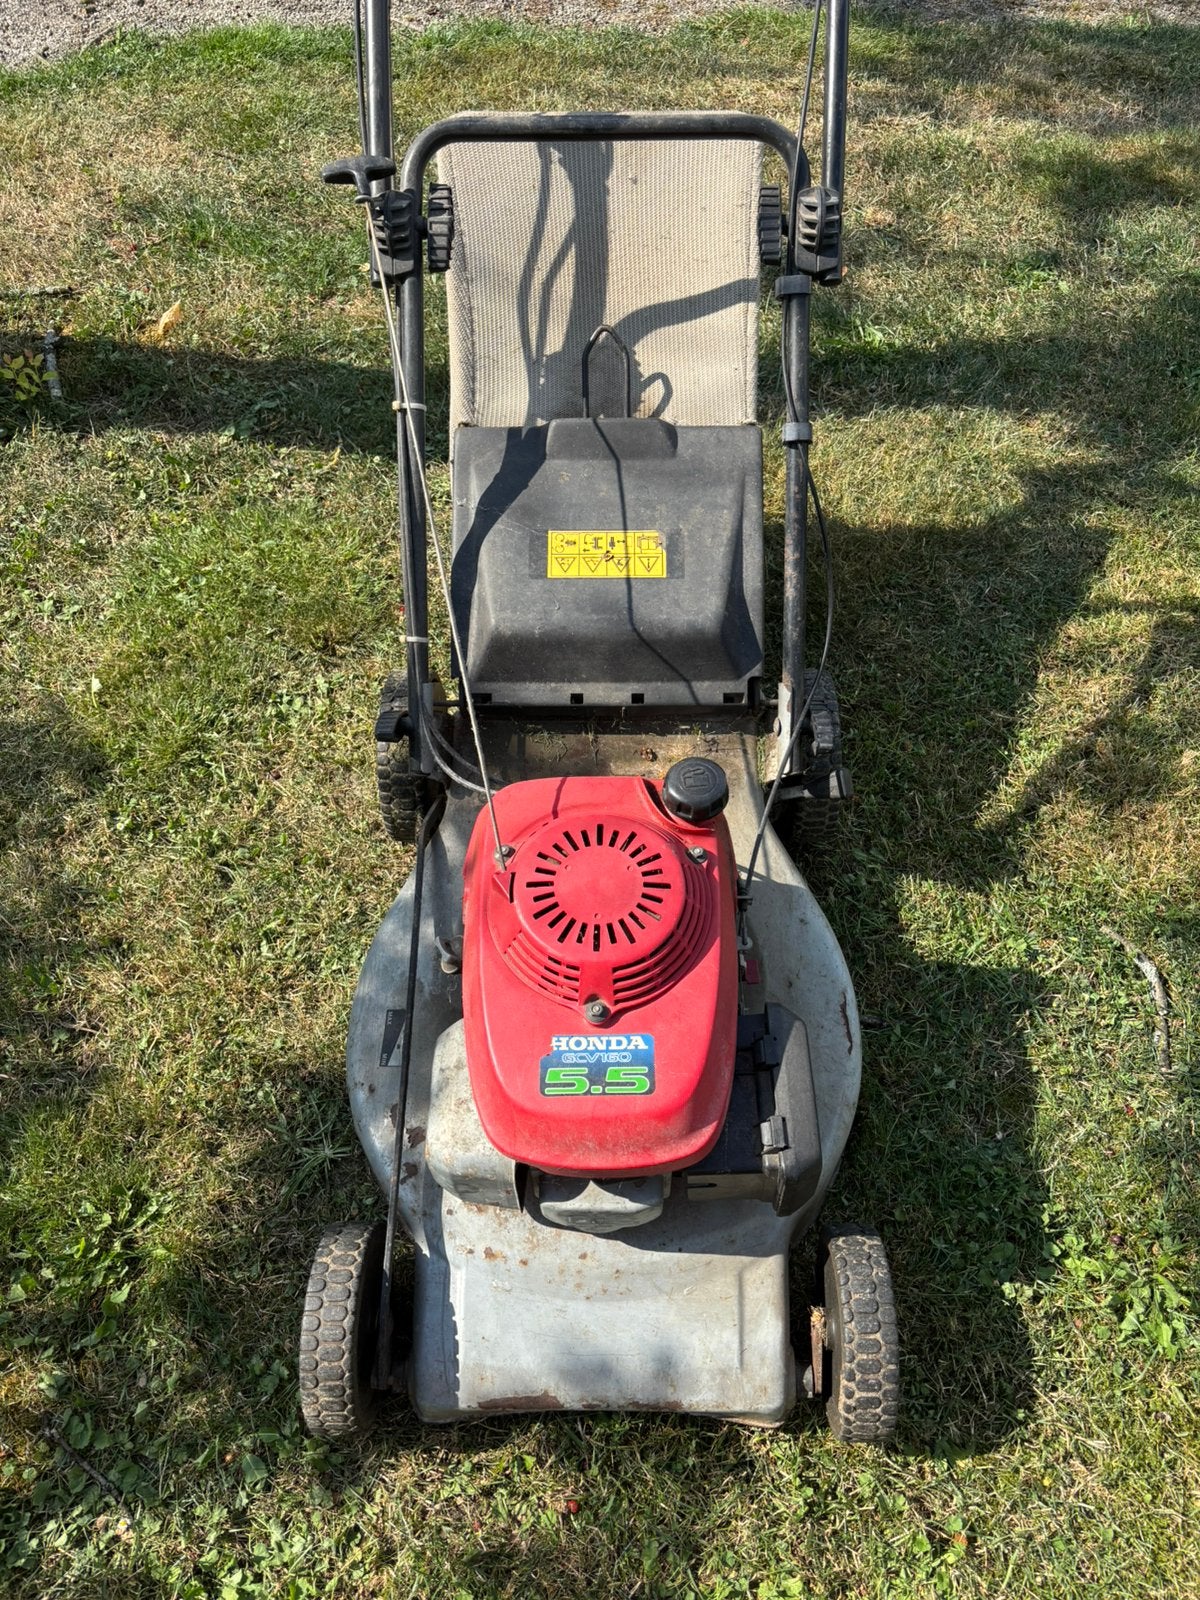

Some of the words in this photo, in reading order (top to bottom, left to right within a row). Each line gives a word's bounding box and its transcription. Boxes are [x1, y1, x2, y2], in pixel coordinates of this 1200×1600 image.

[550, 1035, 648, 1051] HONDA
[380, 1053, 388, 1066] MIN
[561, 1052, 632, 1063] GCV160
[544, 1066, 650, 1095] 5.5
